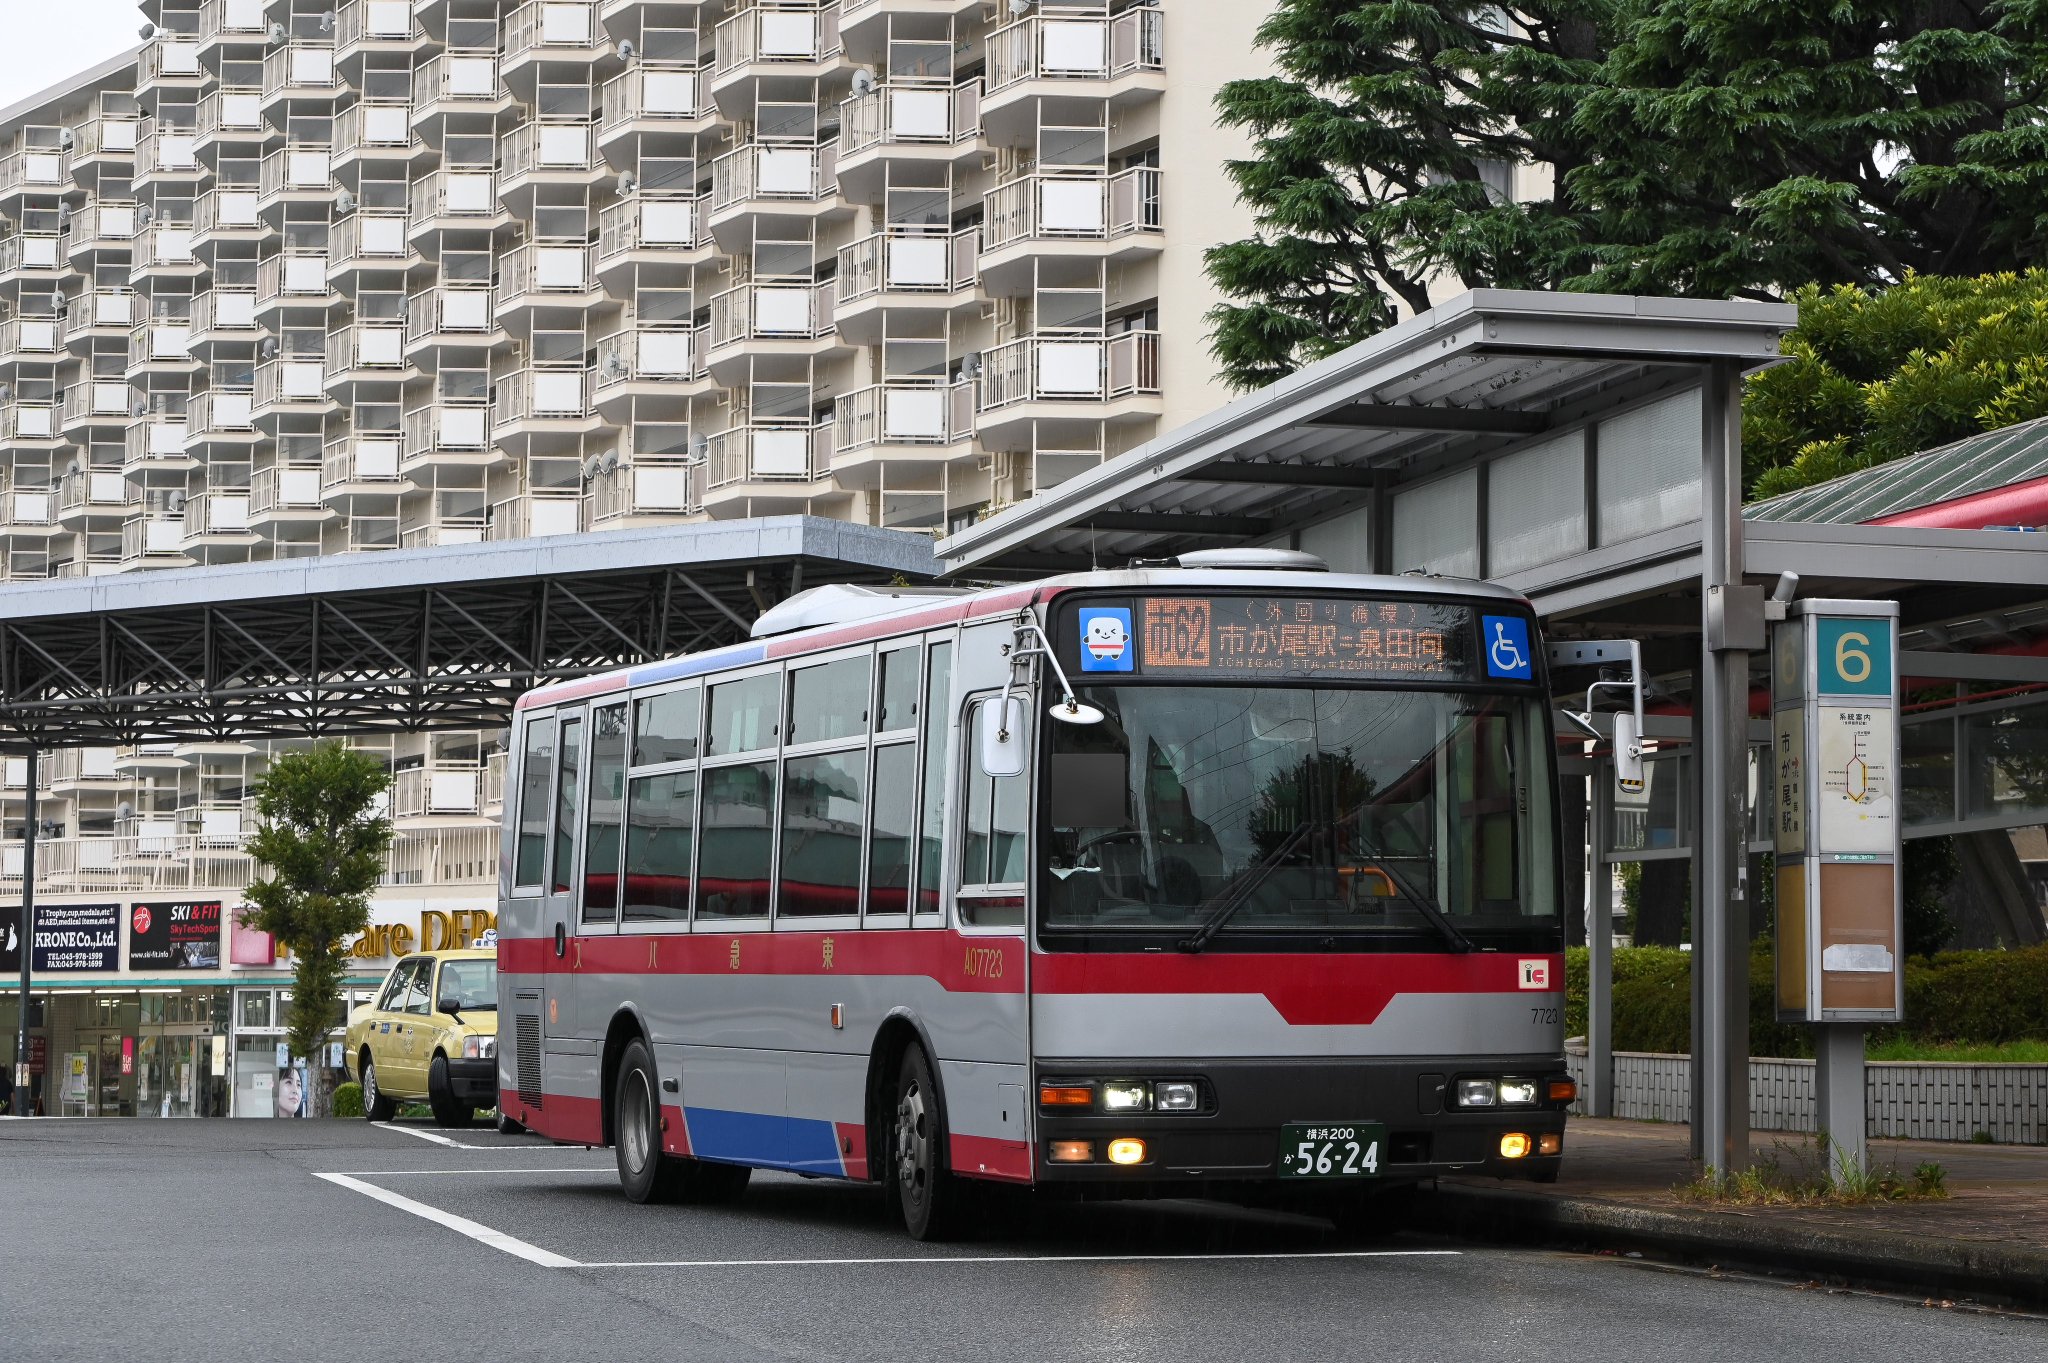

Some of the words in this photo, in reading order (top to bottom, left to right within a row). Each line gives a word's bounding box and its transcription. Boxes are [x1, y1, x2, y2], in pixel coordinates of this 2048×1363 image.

[1781, 635, 1796, 685] 6
[1835, 631, 1871, 683] 6
[1781, 731, 1792, 833] 市が尾駅
[170, 905, 190, 921] SKI
[191, 905, 200, 920] &
[201, 904, 220, 920] FIT
[130, 950, 169, 958] www.ski-fit.info
[1531, 1008, 1558, 1025] 7723
[1283, 1153, 1295, 1165] か
[1296, 1141, 1378, 1175] 56-24
